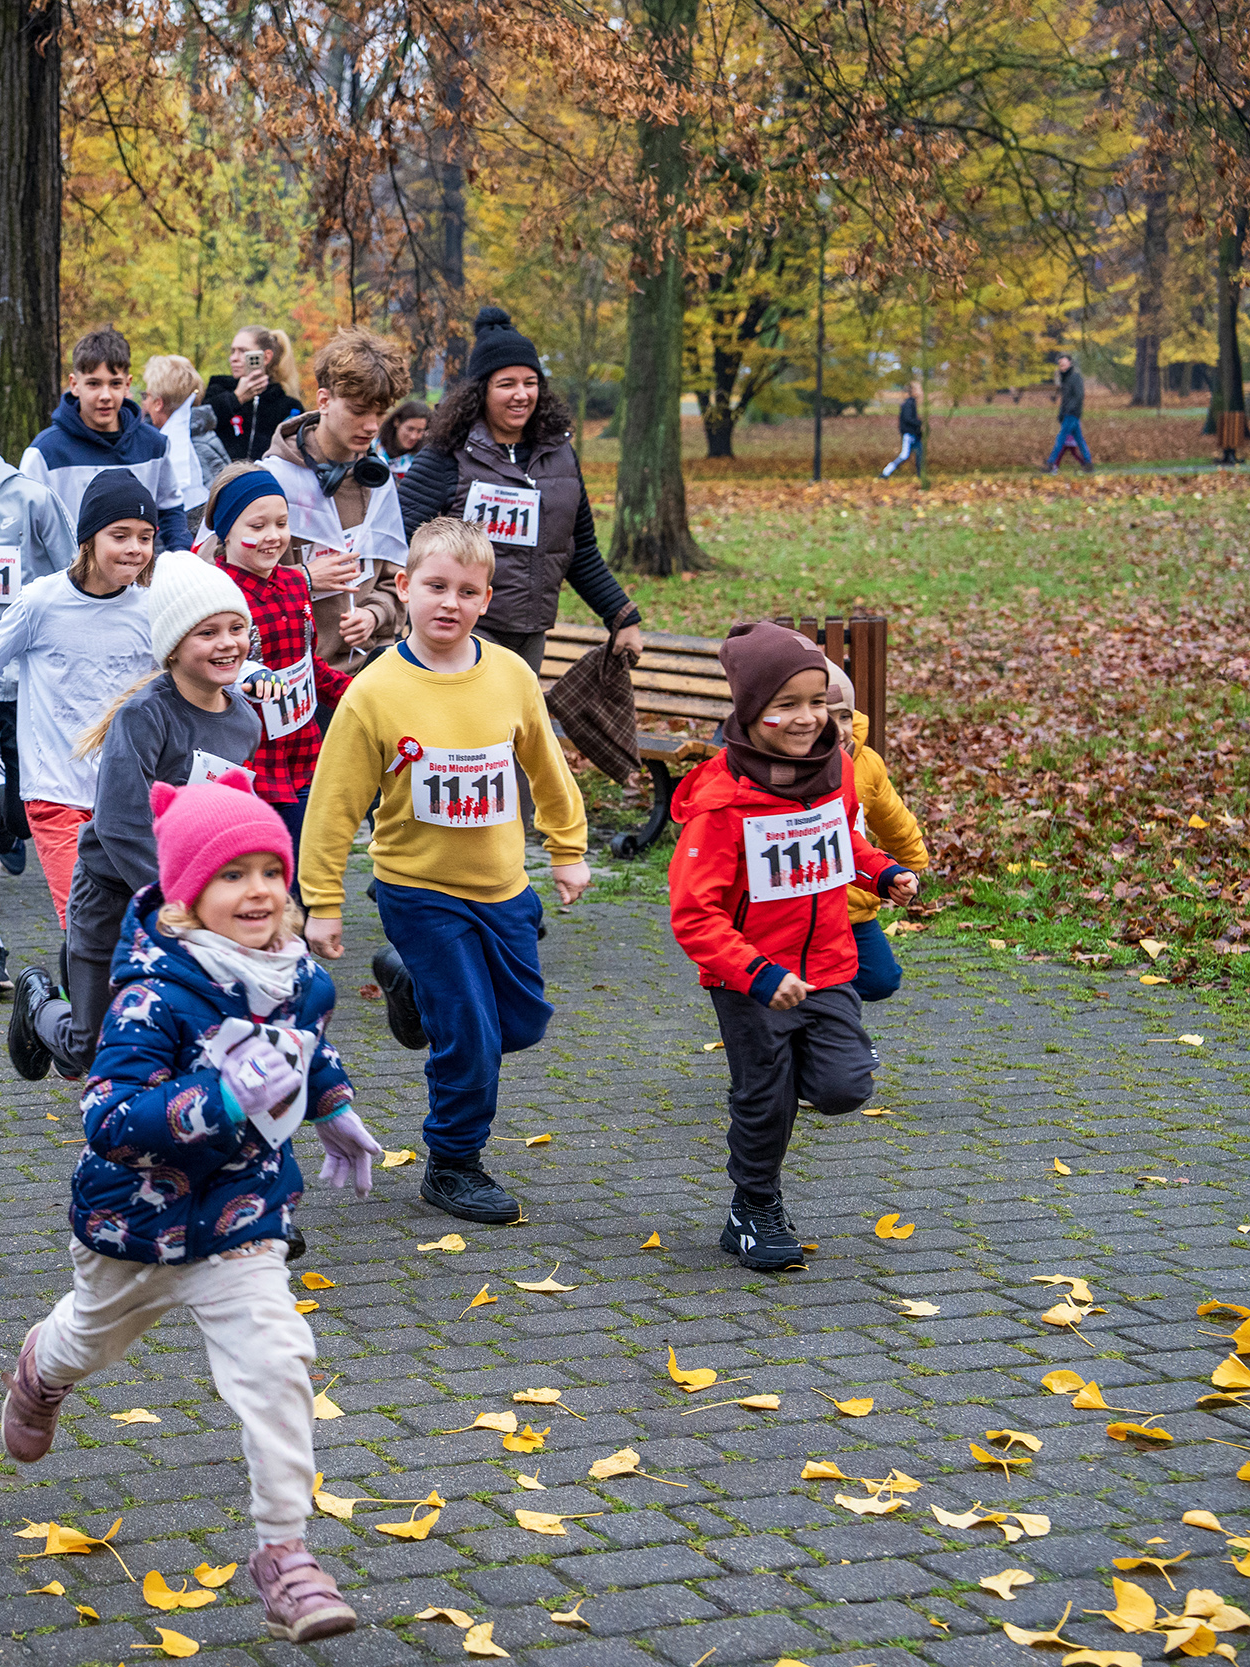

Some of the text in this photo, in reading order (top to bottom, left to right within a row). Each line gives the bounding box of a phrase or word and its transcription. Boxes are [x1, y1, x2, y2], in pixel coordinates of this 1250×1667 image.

[456, 753, 486, 761] listopada
[429, 759, 509, 773] Bieg Młodego Patrioty
